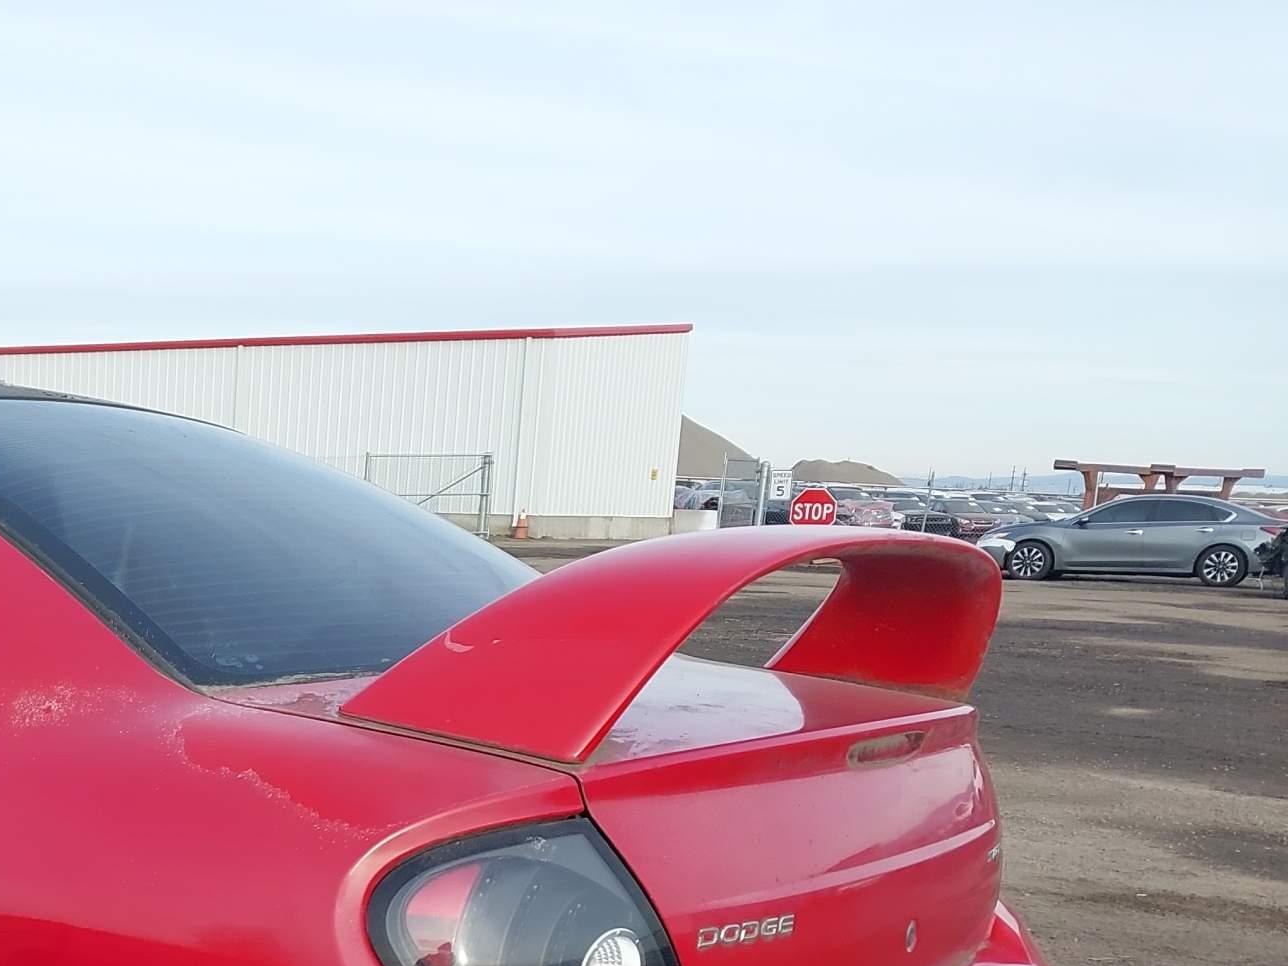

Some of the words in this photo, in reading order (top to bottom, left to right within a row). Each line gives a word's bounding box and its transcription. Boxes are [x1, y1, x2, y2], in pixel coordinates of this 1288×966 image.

[776, 486, 784, 496] 5
[793, 503, 832, 520] STOP
[697, 914, 795, 950] DODGE
